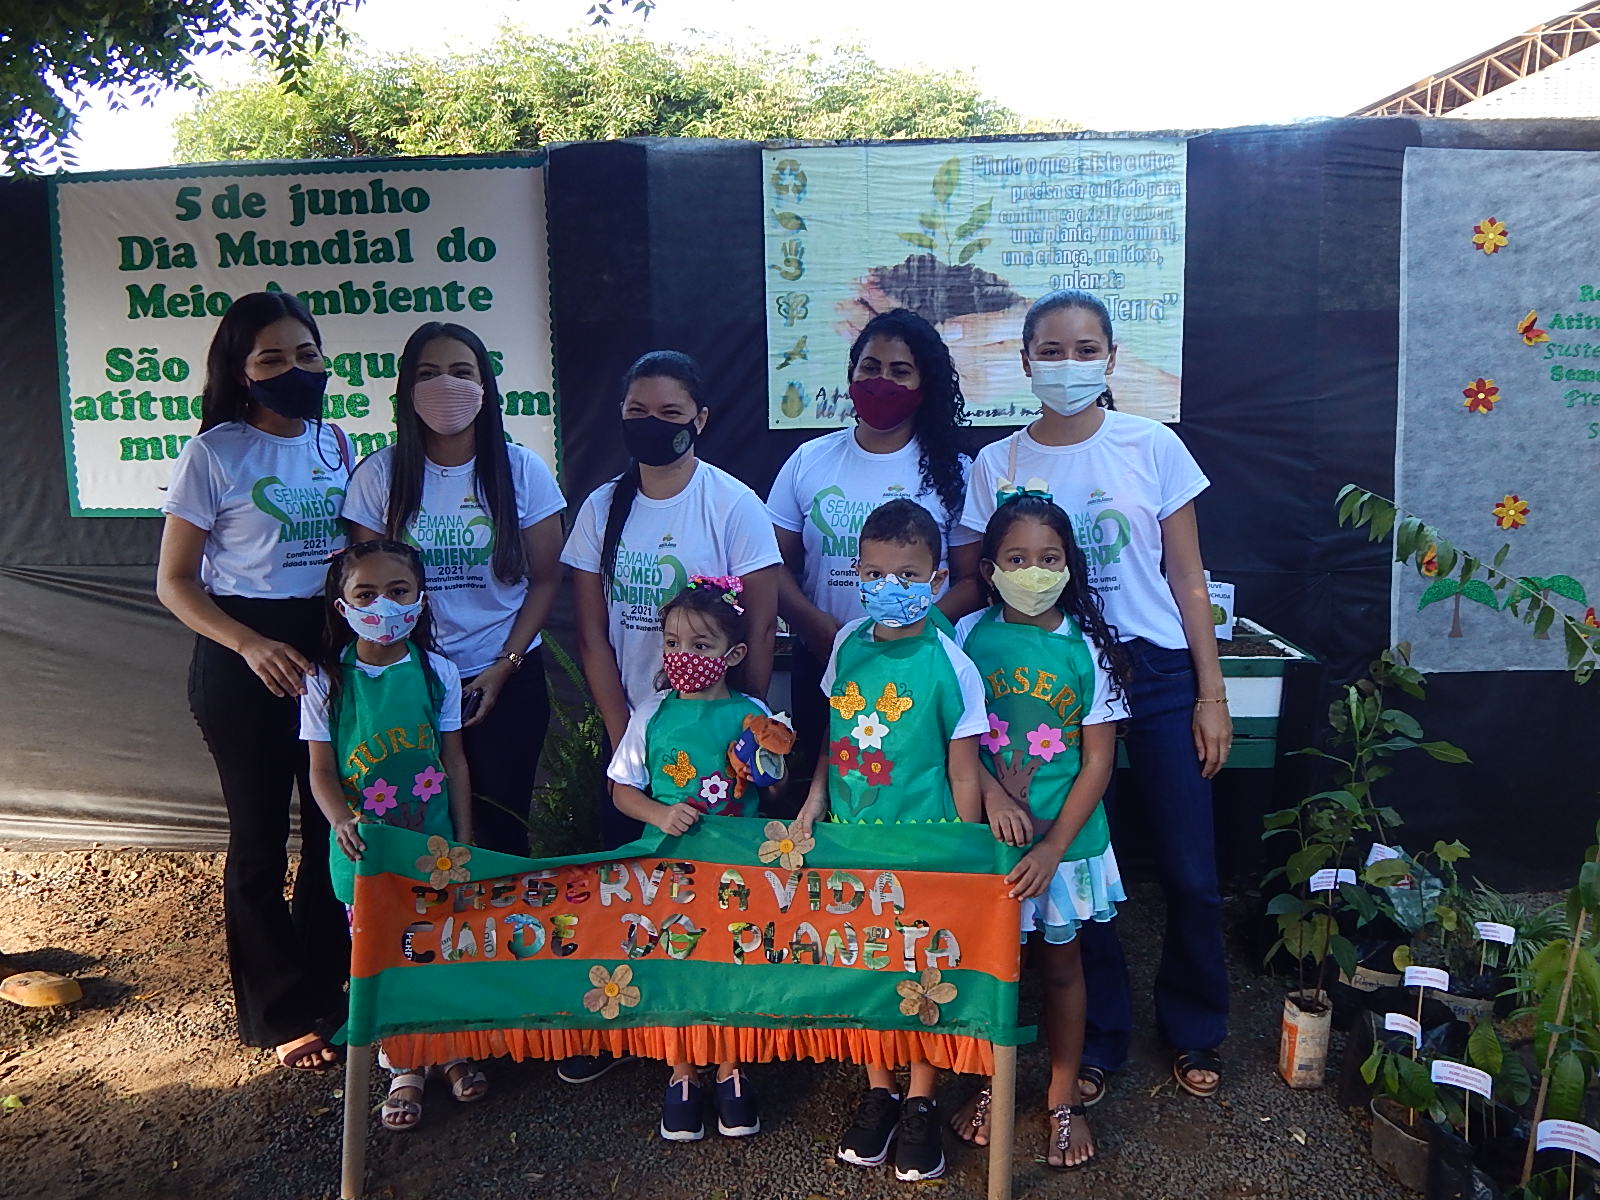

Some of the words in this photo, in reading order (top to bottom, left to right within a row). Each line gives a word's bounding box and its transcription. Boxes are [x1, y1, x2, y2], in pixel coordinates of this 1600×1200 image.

[1026, 157, 1036, 174] o
[1040, 155, 1070, 177] que
[175, 186, 201, 221] 5
[211, 184, 267, 220] de
[289, 178, 431, 226] junho
[1011, 182, 1062, 203] precisa
[1089, 180, 1144, 199] cuidado
[1147, 183, 1181, 201] para
[1011, 229, 1042, 244] uma
[1046, 225, 1097, 246] planta,
[1100, 227, 1123, 243] um
[118, 235, 198, 272] Dia
[216, 228, 415, 269] Mundial
[437, 226, 497, 263] do
[1002, 251, 1034, 266] uma
[1095, 249, 1119, 265] um
[1121, 245, 1164, 264] idoso,
[1050, 275, 1061, 290] o
[1062, 269, 1126, 290] planeta
[125, 283, 233, 320] Meio
[265, 280, 493, 315] mbiente
[105, 347, 190, 383] São
[73, 389, 204, 421] atitu
[274, 487, 324, 502] SEMANA
[286, 501, 300, 515] DO
[300, 497, 336, 519] MEIO
[826, 499, 877, 514] SEMAN
[279, 517, 347, 543] AMBIENT
[831, 514, 849, 527] DO
[303, 539, 327, 550] 2021
[418, 529, 433, 542] DO
[434, 528, 475, 547] MEIO
[419, 547, 488, 567] MBIENTE
[617, 550, 659, 567] EMANA
[424, 575, 465, 583] onstruindo
[438, 566, 464, 576] 2021
[616, 564, 630, 578] DO
[830, 568, 859, 577] Constru
[828, 579, 854, 587] cidade
[411, 861, 696, 915] PRESERVE
[717, 869, 750, 912] A
[764, 870, 905, 916] VIDA
[620, 913, 707, 960] DO
[727, 916, 961, 973] PLANETA
